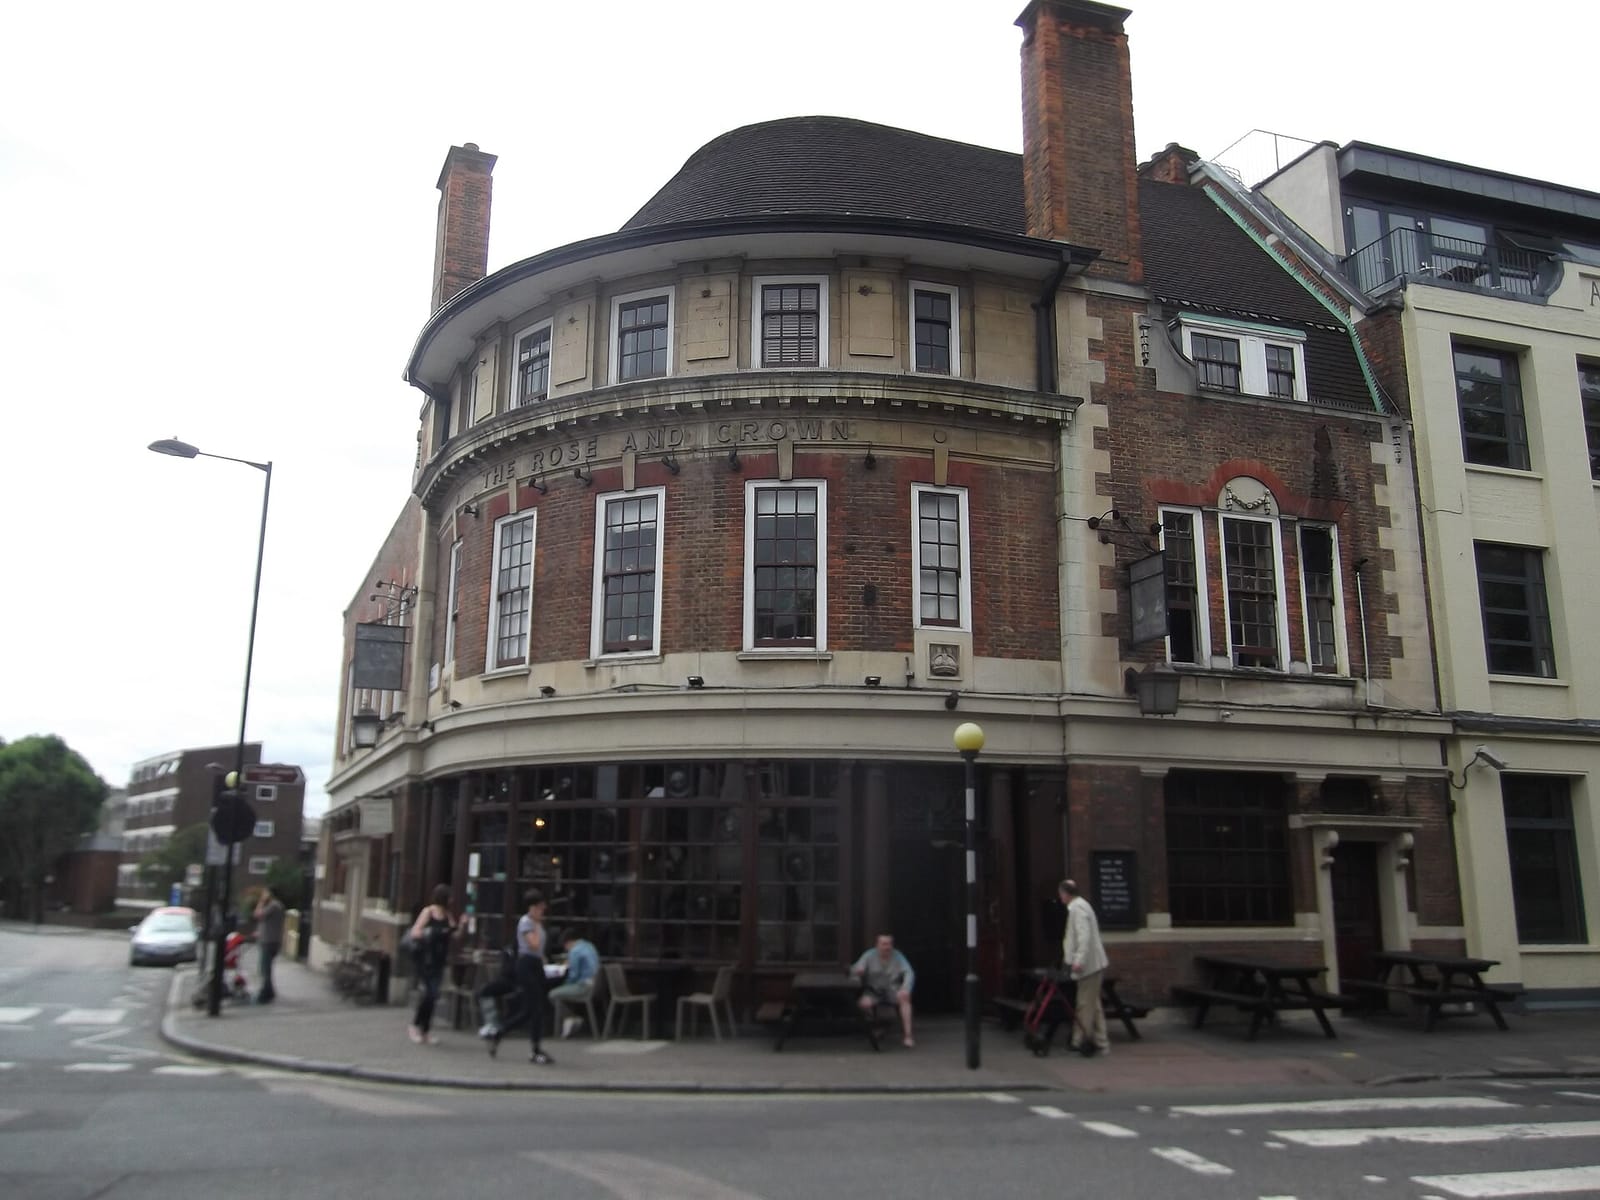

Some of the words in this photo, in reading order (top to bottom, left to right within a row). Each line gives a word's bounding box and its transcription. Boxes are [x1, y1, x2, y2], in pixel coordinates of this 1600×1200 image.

[482, 459, 516, 489] THE
[531, 438, 598, 473] ROSE
[623, 427, 685, 451] AND
[715, 419, 850, 443] CROWN
